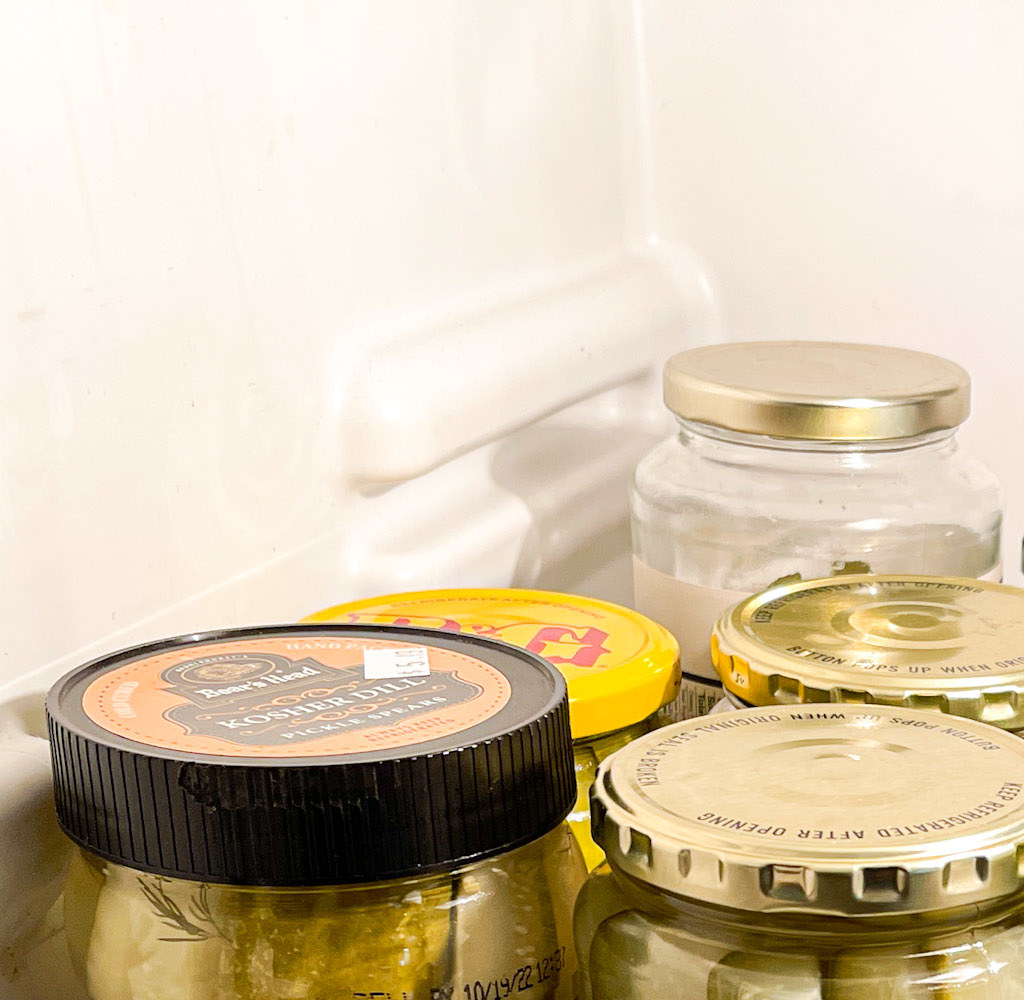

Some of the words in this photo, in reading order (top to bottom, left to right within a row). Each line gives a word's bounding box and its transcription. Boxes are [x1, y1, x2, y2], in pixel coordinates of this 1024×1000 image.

[909, 666, 932, 674] UP
[940, 664, 992, 675] WHEN
[195, 677, 267, 699] Boar's
[264, 666, 320, 685] Head
[217, 696, 355, 729] KOSHER
[350, 679, 427, 700] DILL
[280, 717, 366, 739] PICKLE
[367, 696, 447, 720] SPEARS
[695, 714, 781, 734] ORIGINAL
[789, 712, 847, 722] WHEN
[889, 717, 939, 730] POPS
[658, 732, 698, 748] SEAL
[940, 727, 1001, 751] BUTTON
[646, 748, 667, 757] IS
[636, 757, 661, 787] BROKEN
[996, 782, 1023, 801] KEEP
[697, 812, 787, 837] OPENING
[877, 801, 1005, 839] REFRIGERATED
[797, 829, 864, 840] AFTER
